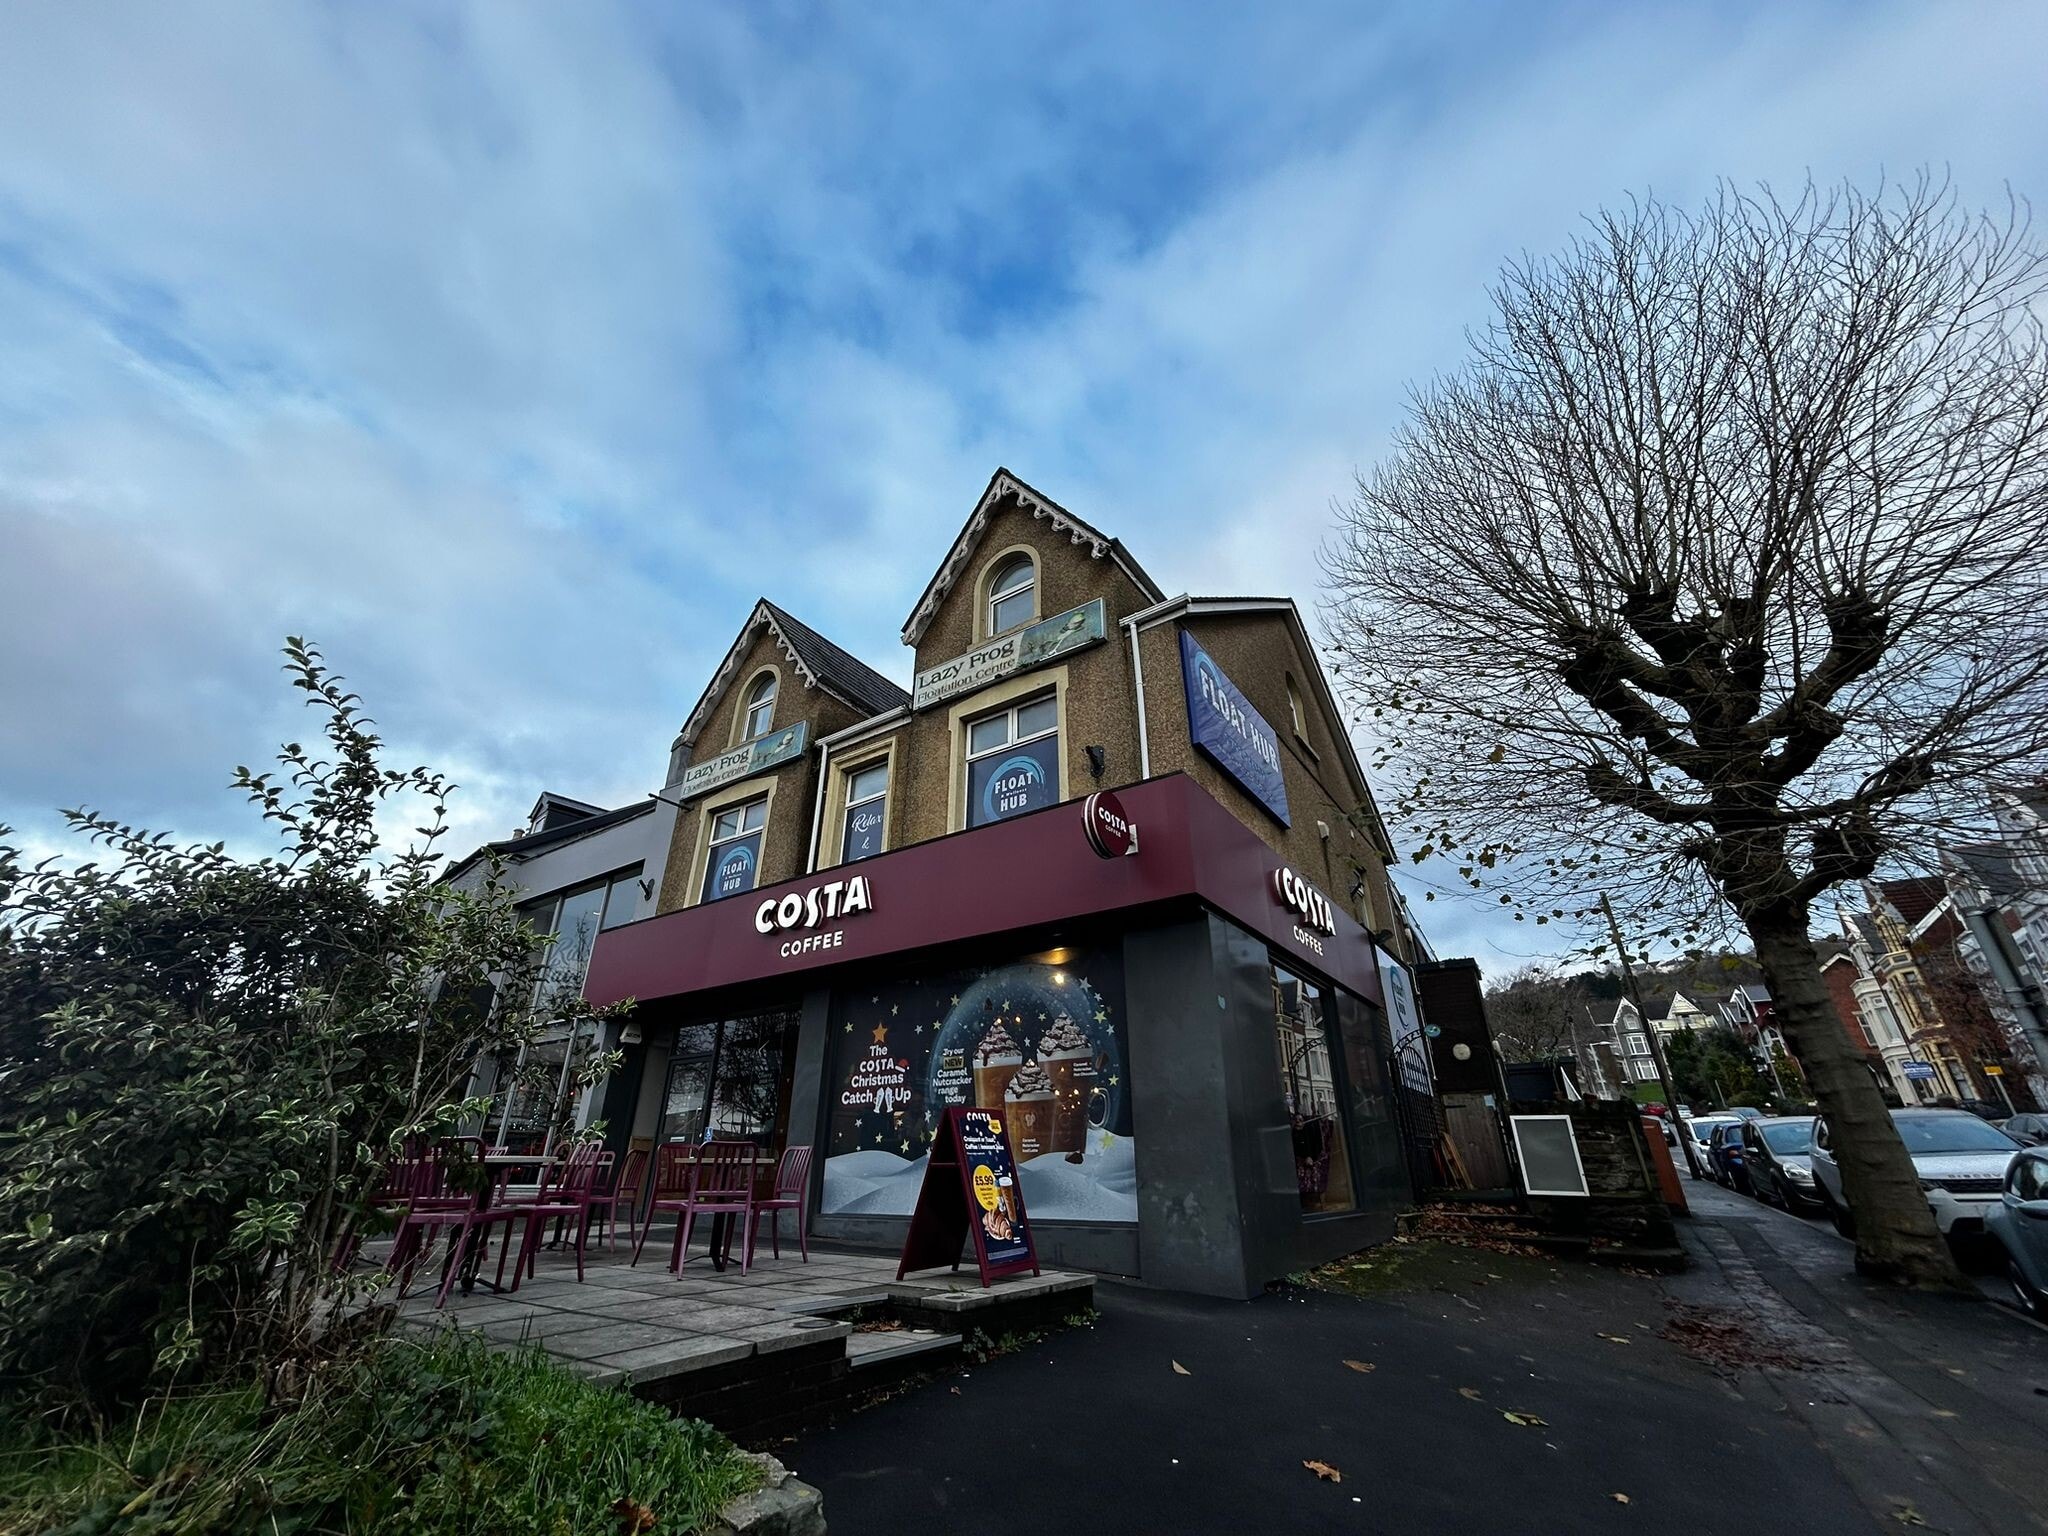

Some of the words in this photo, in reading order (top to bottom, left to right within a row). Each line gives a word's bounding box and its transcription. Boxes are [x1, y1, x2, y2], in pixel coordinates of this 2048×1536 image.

[918, 661, 964, 690] Lazy
[969, 639, 1015, 669] Frog
[975, 657, 1016, 678] Centre
[1199, 667, 1247, 739] FLOAT
[1250, 723, 1279, 773] HUB
[686, 762, 718, 783] Lazy
[720, 749, 750, 769] Frog
[995, 772, 1033, 794] FLOAT
[1001, 793, 1027, 812] HUB
[851, 812, 884, 833] Relax
[1098, 806, 1127, 833] COSTA
[1105, 824, 1122, 838] COFFEE
[861, 836, 870, 850] &
[722, 859, 747, 876] FLOAT
[723, 877, 741, 891] HUB
[755, 876, 870, 934] COSTA
[1280, 867, 1336, 937] COSTA
[781, 930, 843, 958] COFFEE
[1293, 924, 1324, 957] COFFEE
[869, 1045, 888, 1057] The
[860, 1058, 894, 1073] COSTA
[944, 1057, 963, 1068] NEW
[851, 1073, 904, 1088] Christmas
[937, 1067, 968, 1078] Caramel
[932, 1076, 972, 1087] Nutcracker
[841, 1089, 873, 1105] Catch
[894, 1087, 911, 1104] Up
[937, 1086, 959, 1096] range
[945, 1094, 966, 1104] today
[975, 1175, 994, 1186] £5.99
